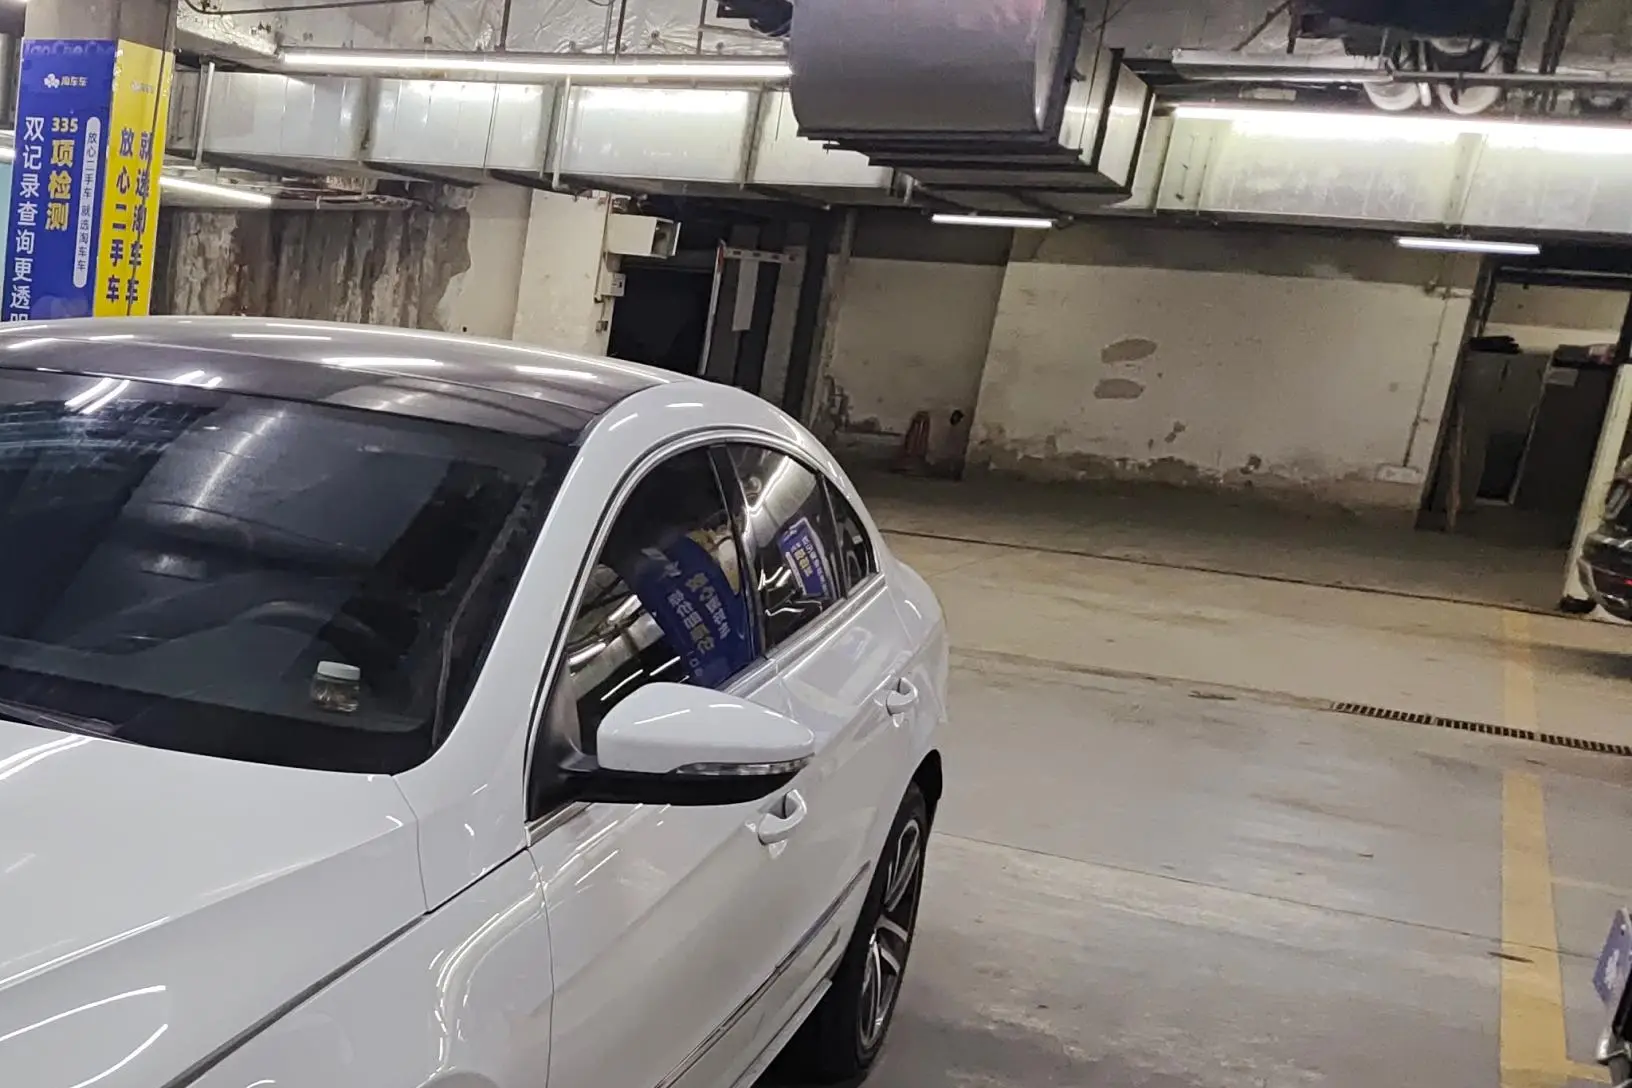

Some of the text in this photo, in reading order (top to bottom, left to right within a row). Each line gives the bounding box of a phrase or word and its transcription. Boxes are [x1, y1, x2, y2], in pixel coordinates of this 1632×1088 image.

[106, 127, 135, 304] 放心二手车
